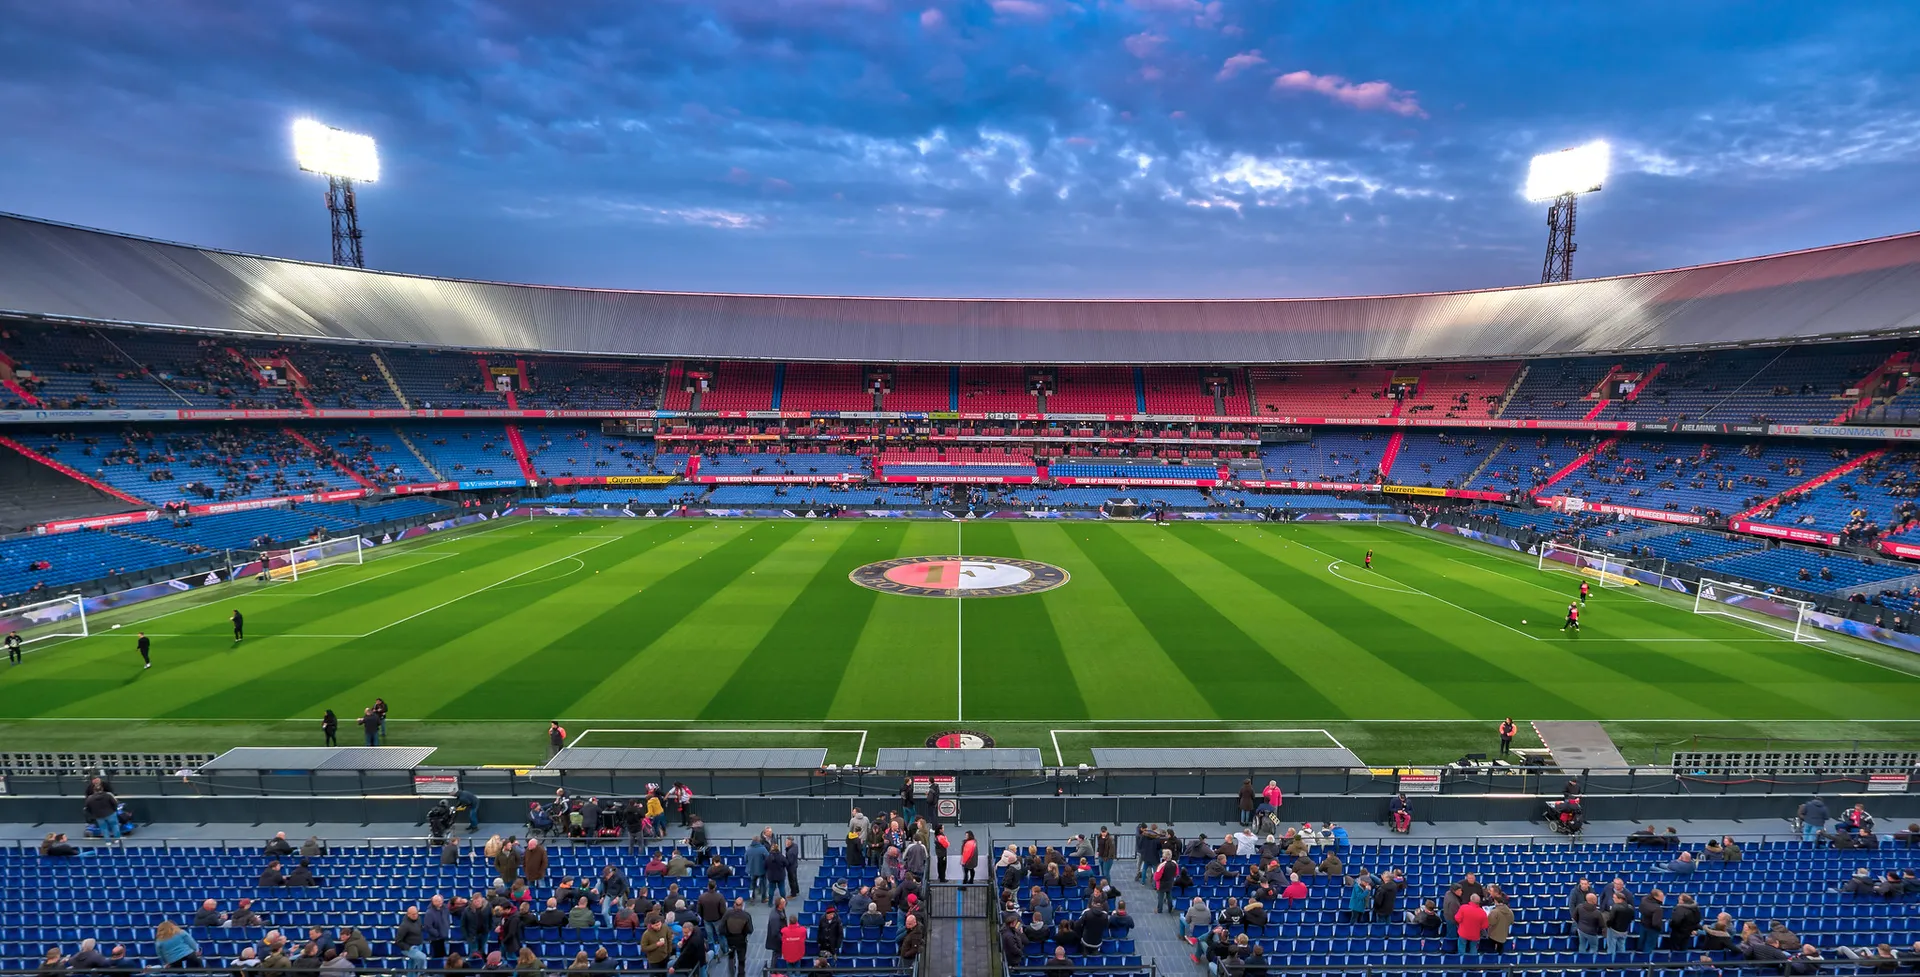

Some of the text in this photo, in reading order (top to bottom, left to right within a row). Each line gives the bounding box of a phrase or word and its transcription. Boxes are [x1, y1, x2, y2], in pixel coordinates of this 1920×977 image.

[1682, 424, 1717, 432] HELMINK
[1783, 426, 1912, 437] VLS SCHOONMAAK VLS
[1385, 485, 1415, 493] Qurrent
